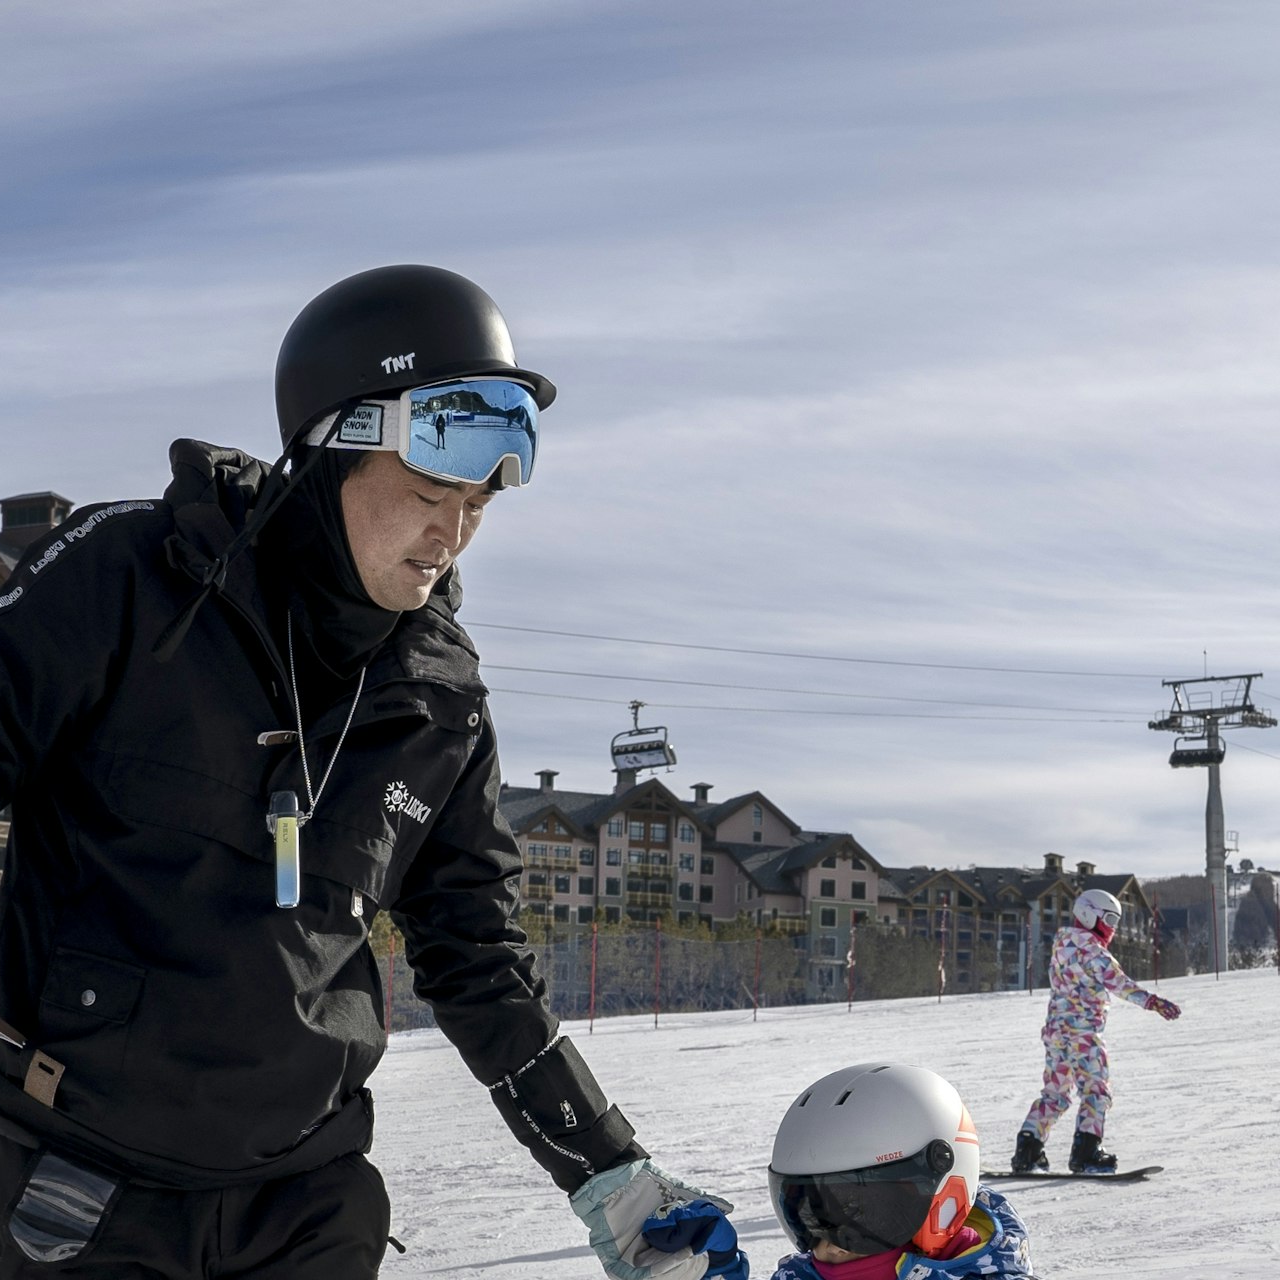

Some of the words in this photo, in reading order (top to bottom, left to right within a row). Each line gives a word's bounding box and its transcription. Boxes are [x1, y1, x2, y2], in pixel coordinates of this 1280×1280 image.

[381, 352, 415, 374] TNT
[349, 410, 374, 420] ANDN
[344, 420, 369, 431] SNOW
[521, 1109, 541, 1133] GEAR
[541, 1132, 586, 1162] ORIGINAL
[875, 1151, 904, 1162] WEDZE
